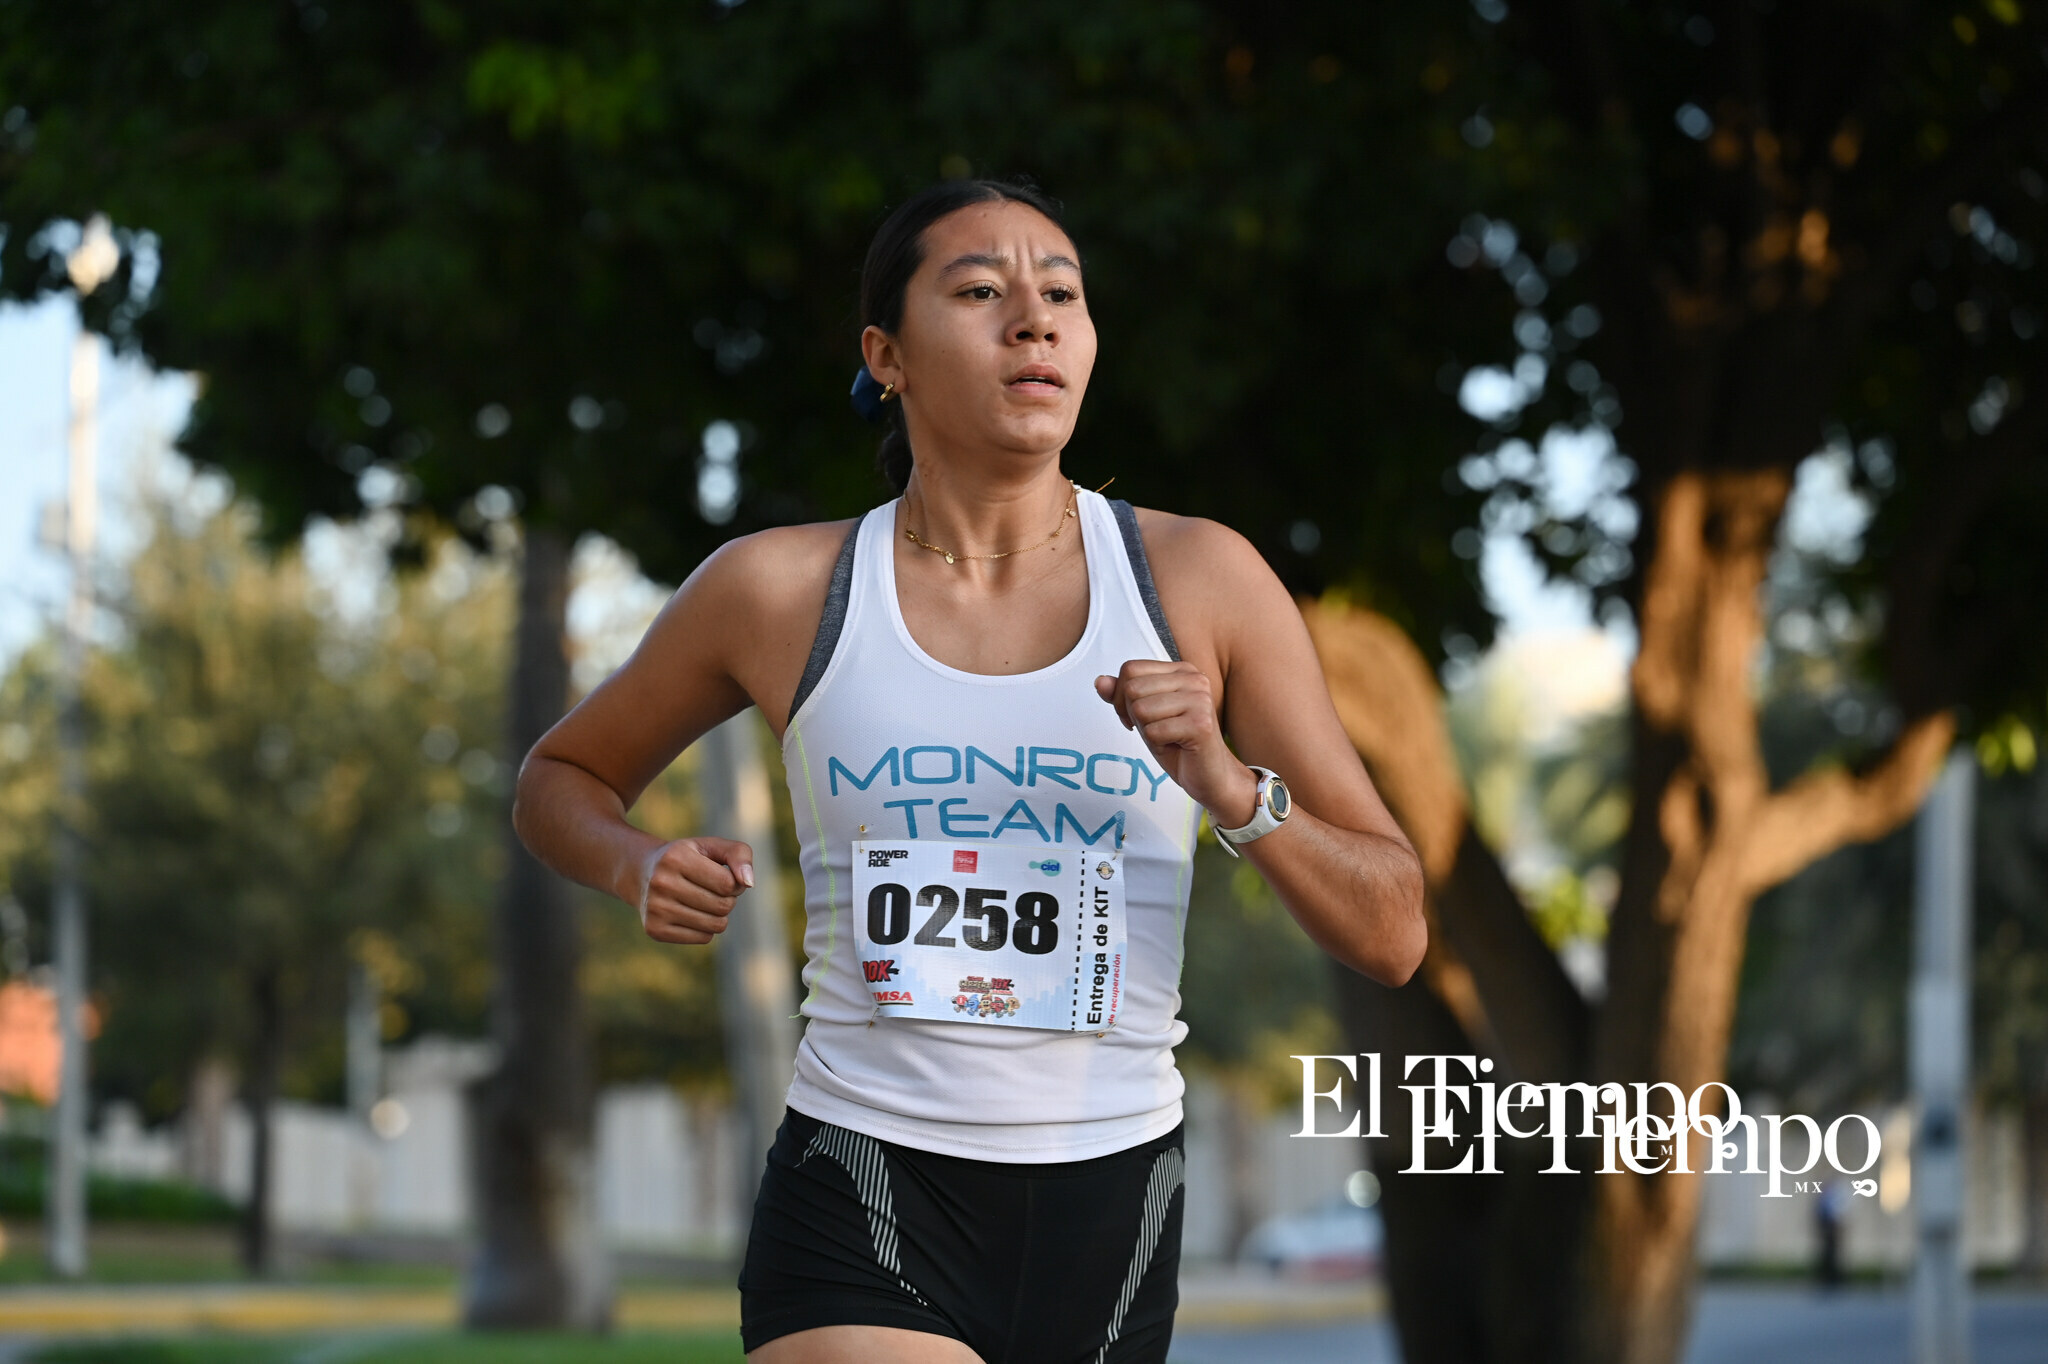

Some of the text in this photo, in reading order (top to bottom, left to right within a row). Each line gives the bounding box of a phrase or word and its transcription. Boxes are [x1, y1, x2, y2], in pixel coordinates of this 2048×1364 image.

[828, 745, 1170, 802] MONROY
[883, 797, 1126, 849] TEAM
[868, 850, 909, 860] POWER
[868, 859, 891, 868] ADE
[1040, 861, 1060, 872] ciel
[867, 883, 1060, 955] 0258
[1087, 886, 1109, 1025] Entrega de KIT
[1111, 953, 1121, 1012] recuperación
